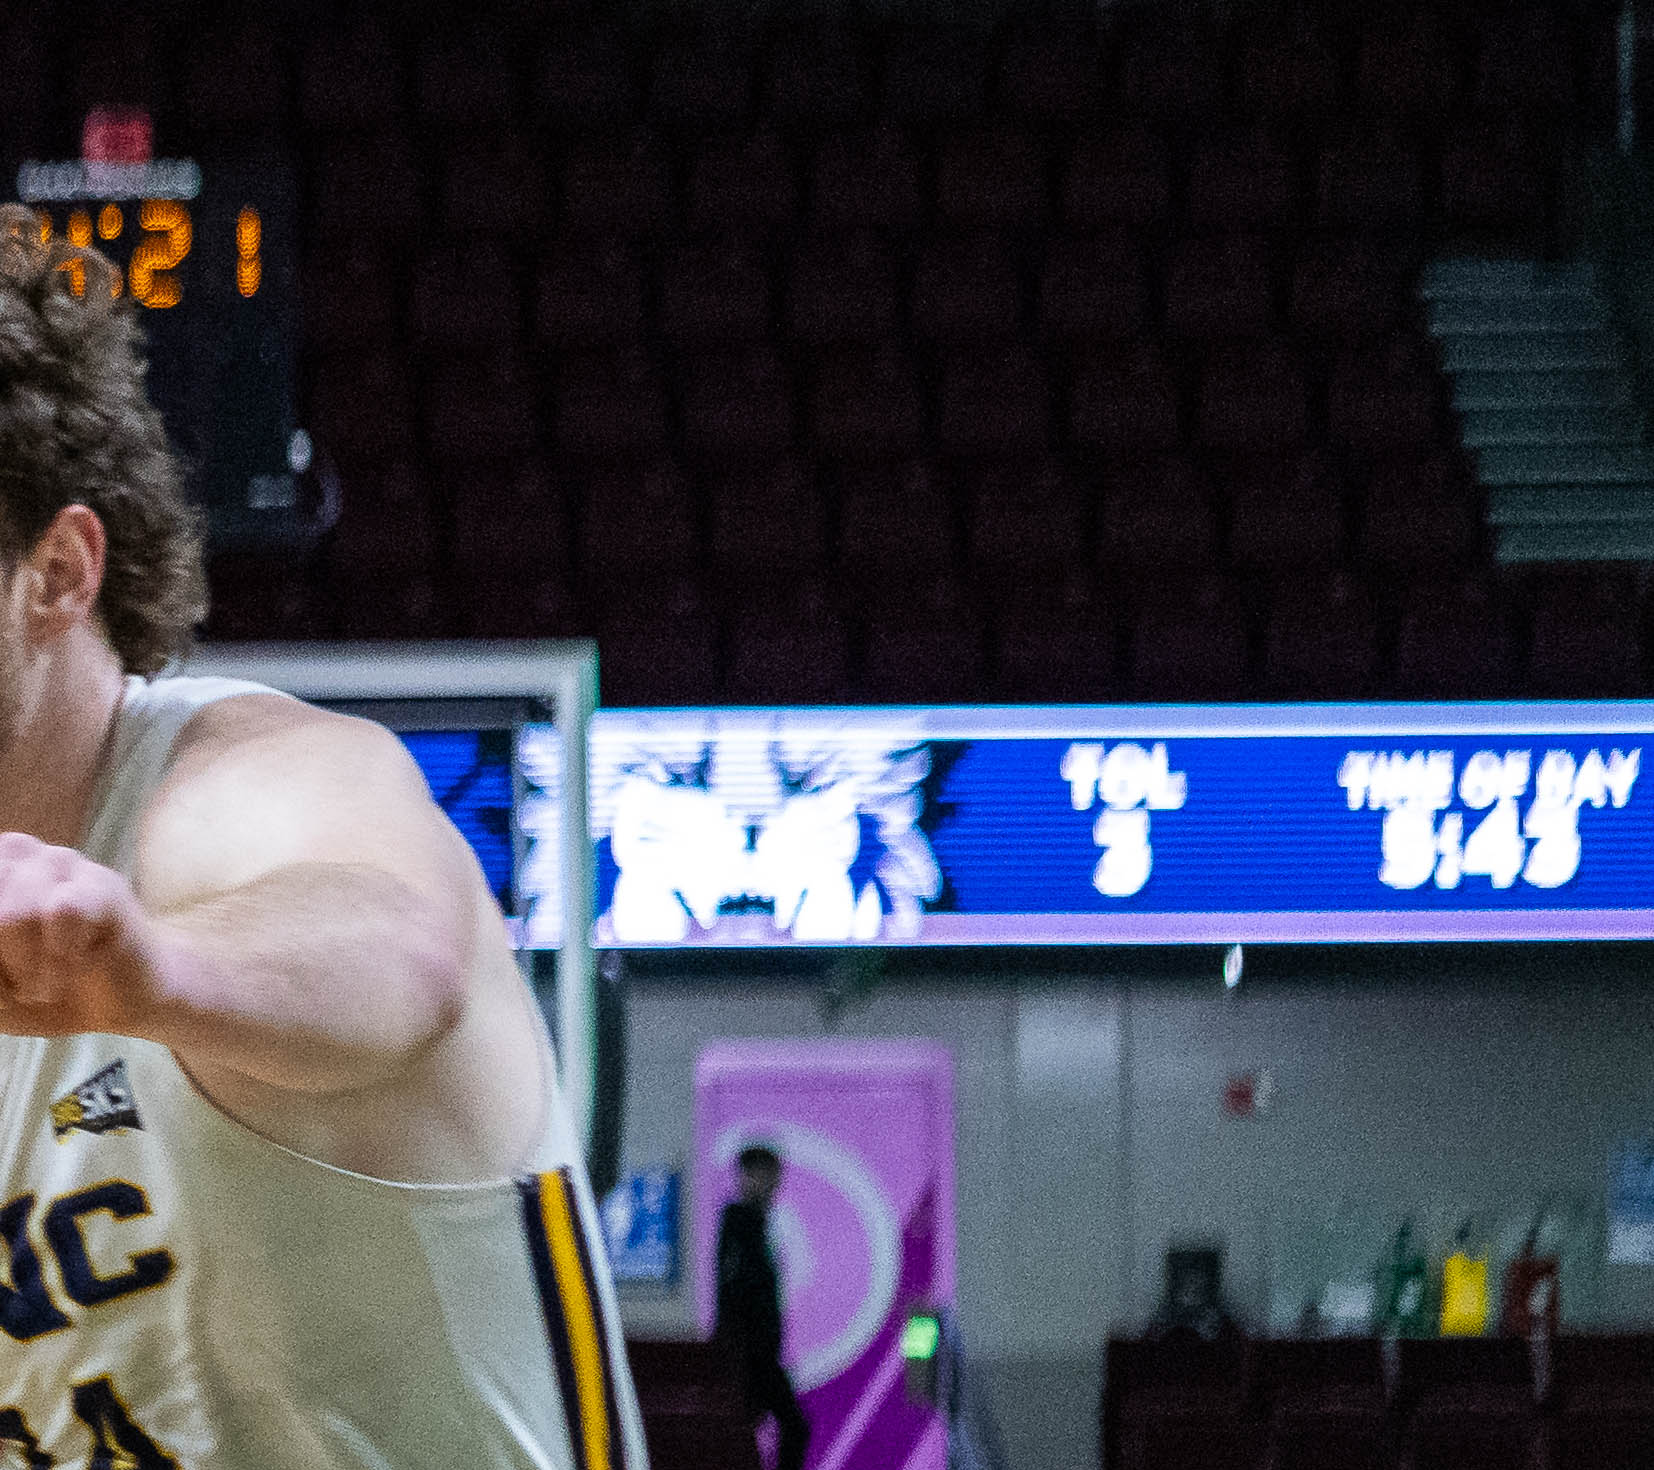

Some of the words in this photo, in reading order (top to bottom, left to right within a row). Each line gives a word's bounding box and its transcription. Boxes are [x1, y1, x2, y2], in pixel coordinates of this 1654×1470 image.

[1061, 742, 1187, 811] TOL
[1339, 750, 1453, 810] TIME
[1459, 750, 1530, 809] OF
[1536, 749, 1641, 809] DAY
